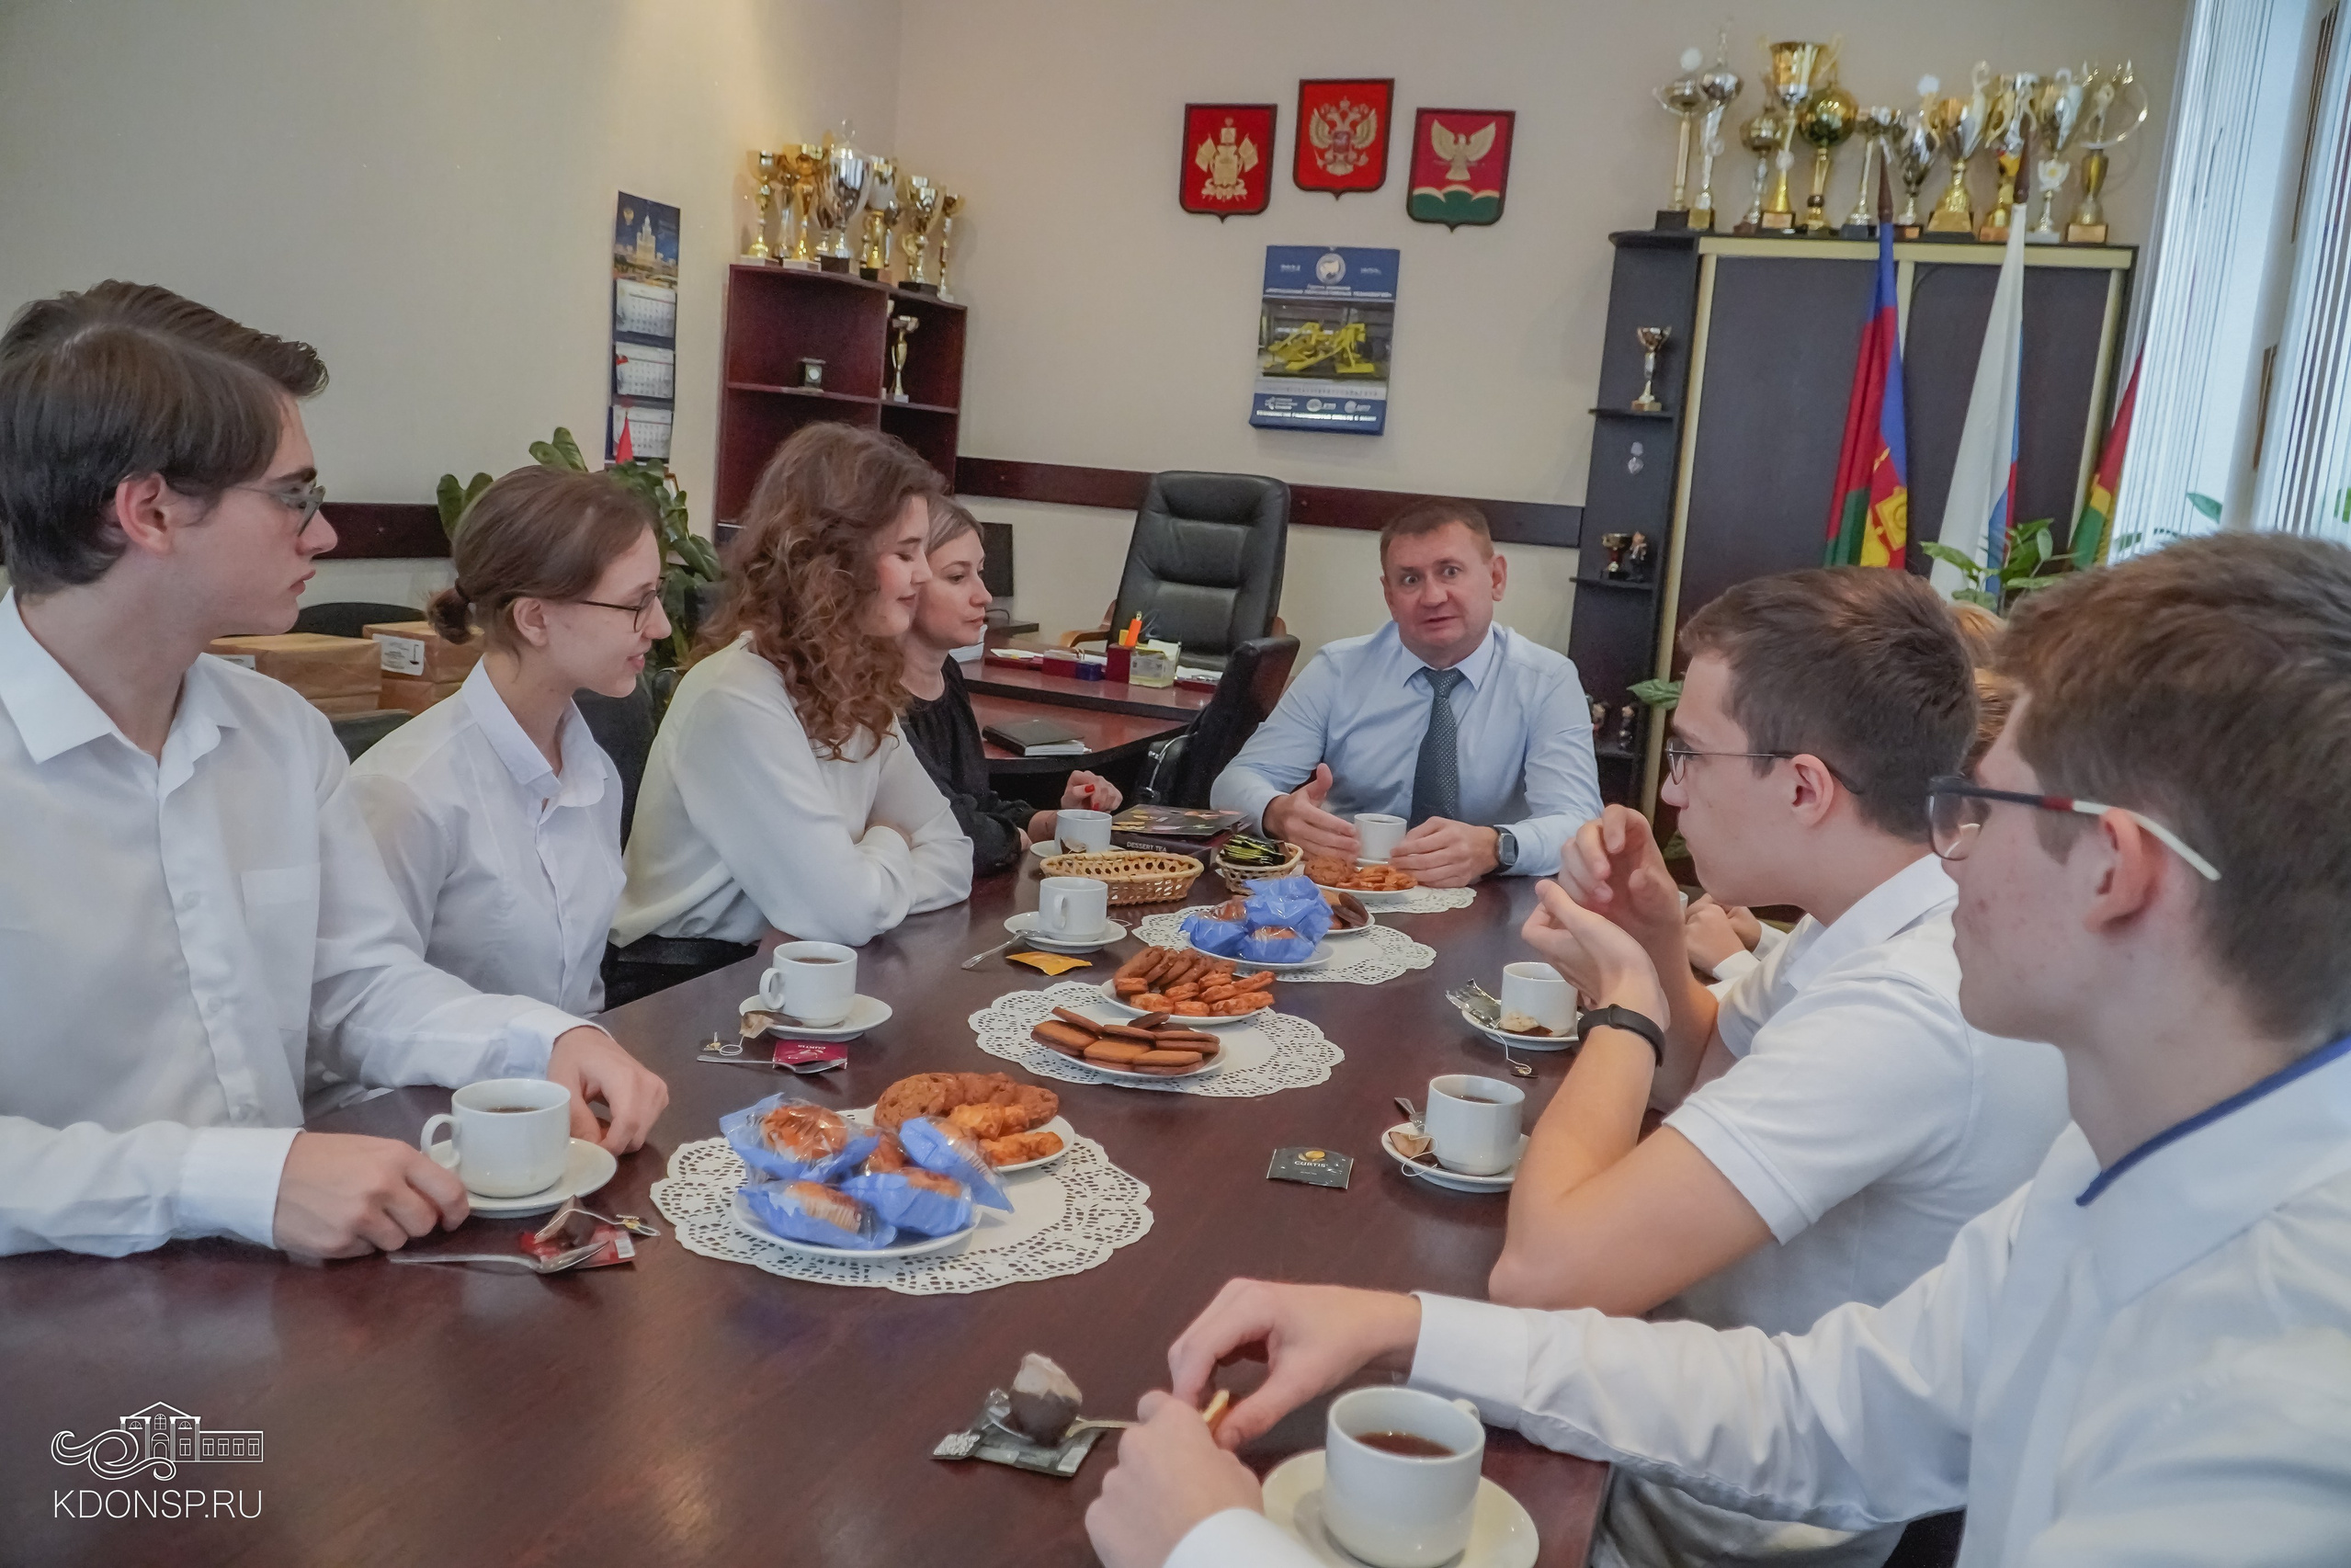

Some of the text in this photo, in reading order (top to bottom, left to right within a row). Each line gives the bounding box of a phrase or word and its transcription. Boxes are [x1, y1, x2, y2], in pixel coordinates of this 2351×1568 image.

[1126, 841, 1167, 853] DESSERT TEA
[1294, 1160, 1326, 1168] CURTIS
